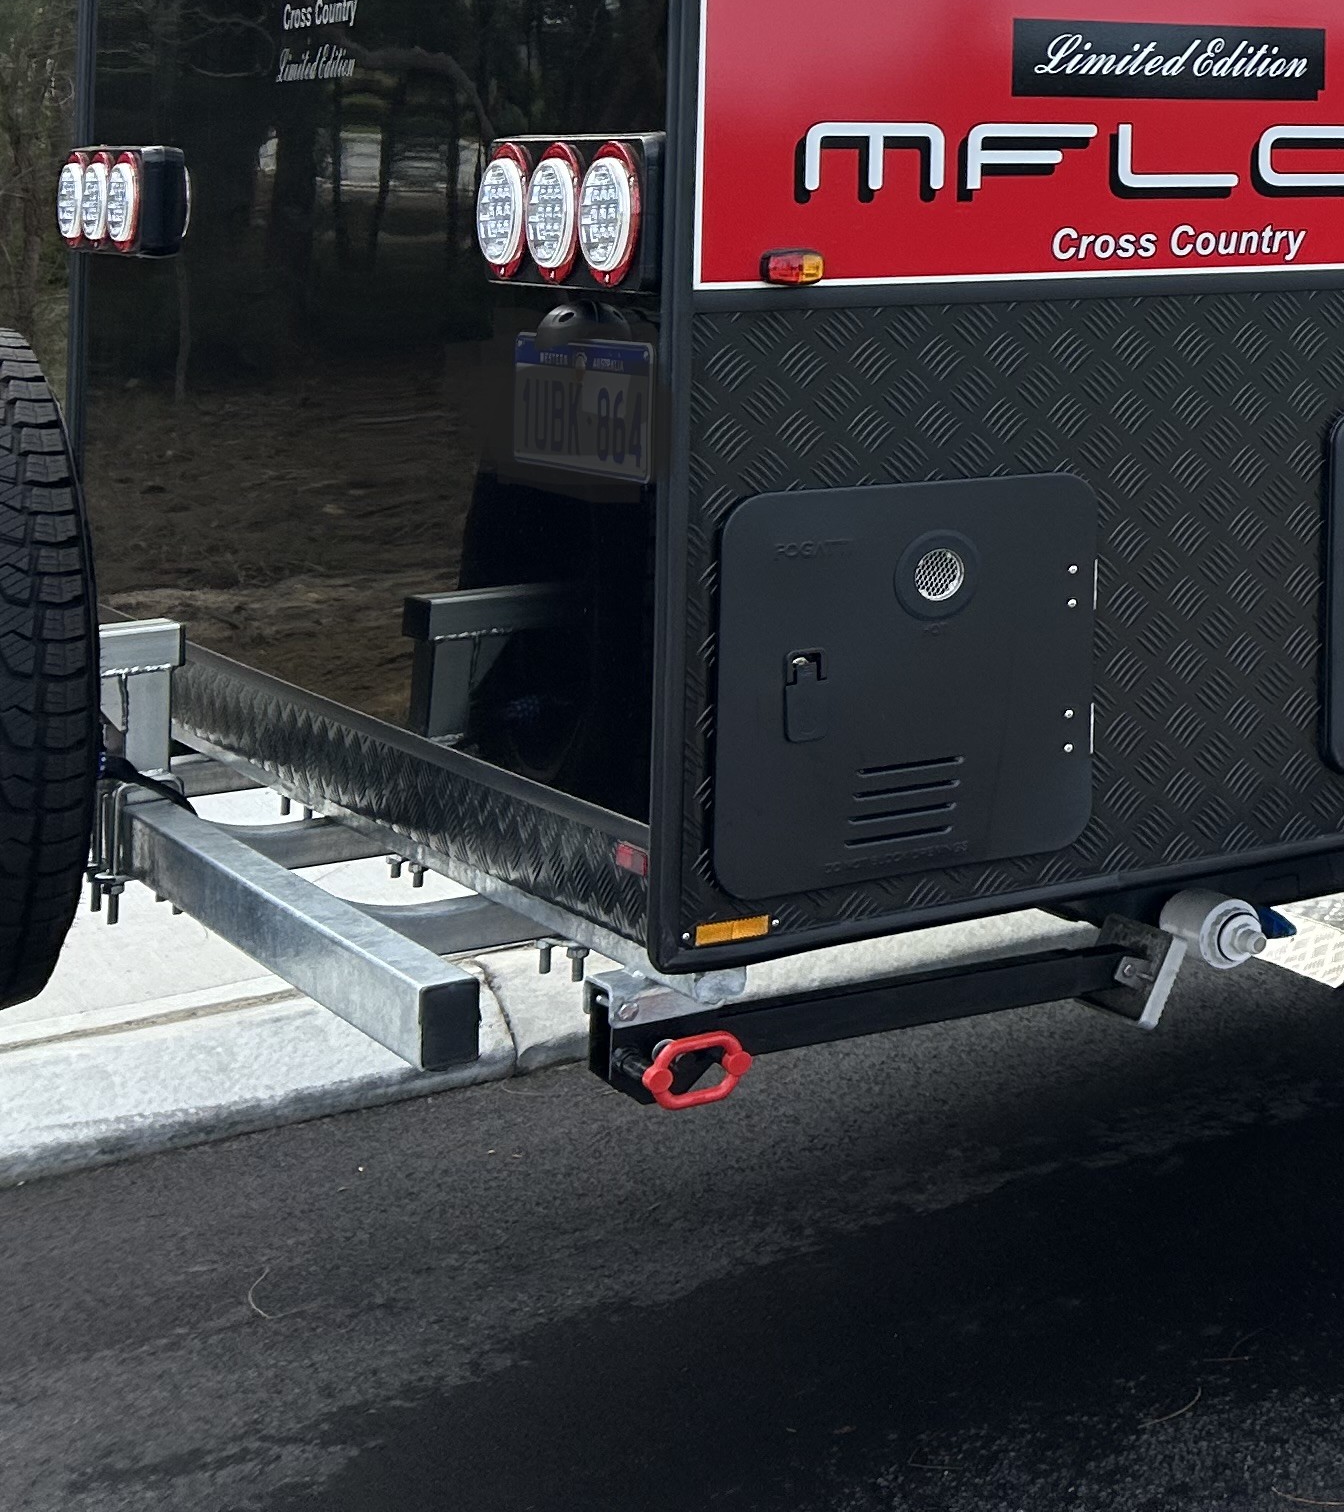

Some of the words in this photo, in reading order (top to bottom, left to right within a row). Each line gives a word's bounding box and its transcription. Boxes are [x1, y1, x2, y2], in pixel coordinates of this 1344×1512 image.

[283, 3, 313, 30] Cross
[276, 44, 323, 83] Limited
[318, 43, 356, 79] Edition
[1034, 34, 1200, 76] Limited
[1192, 37, 1308, 78] Edition
[1053, 227, 1157, 260] Cross
[1170, 224, 1307, 262] Country
